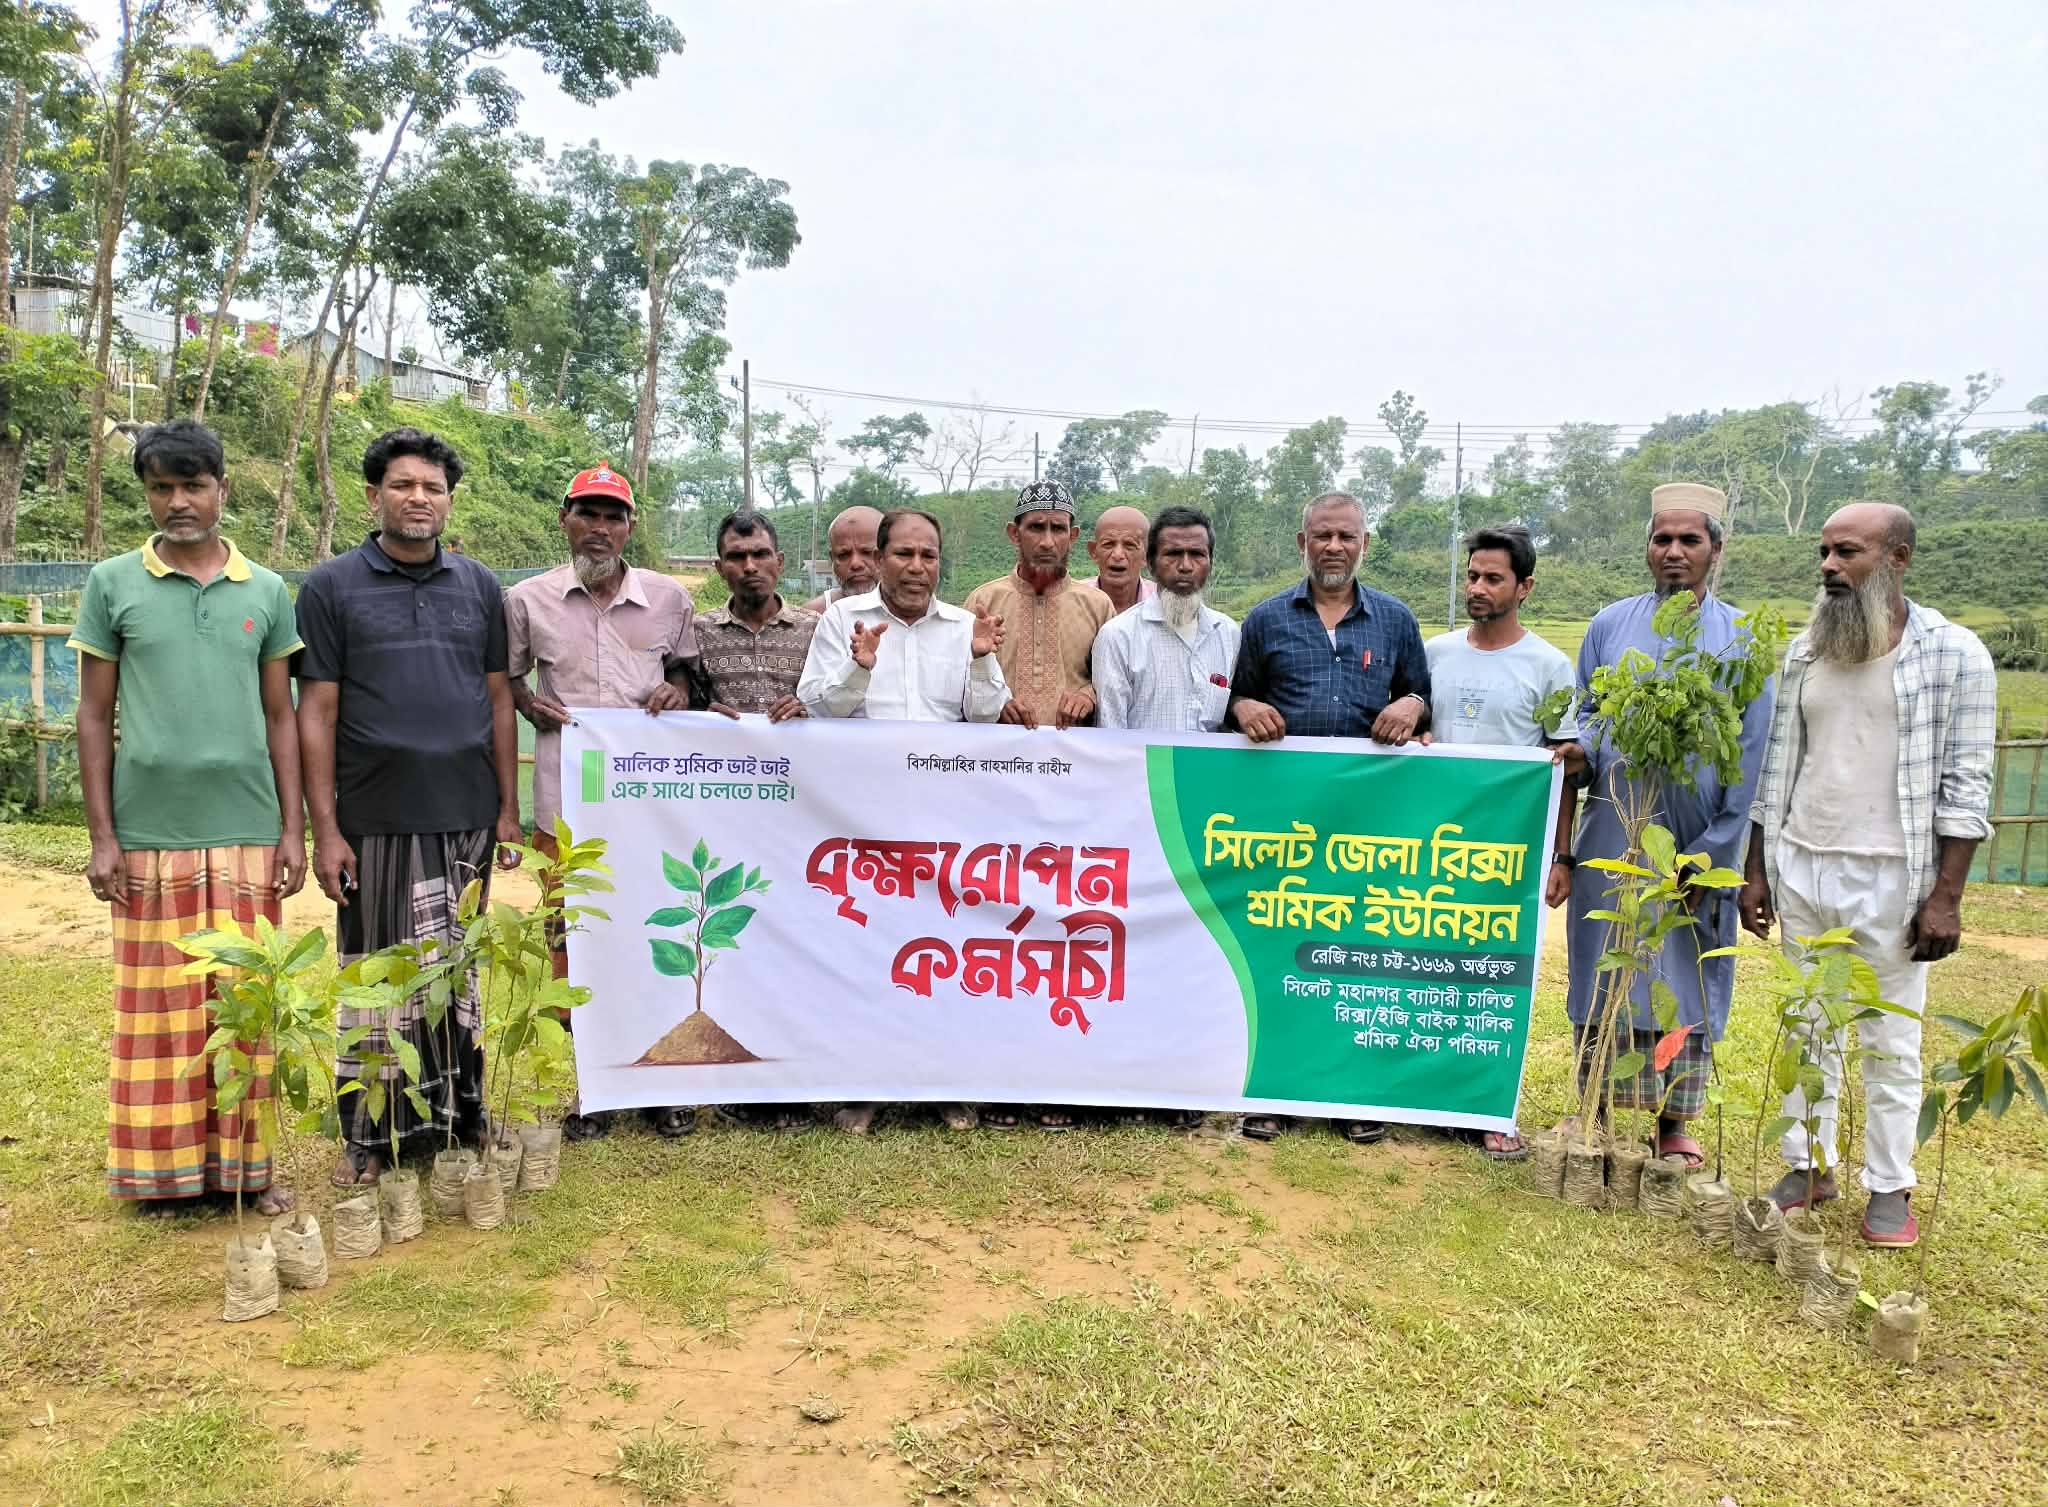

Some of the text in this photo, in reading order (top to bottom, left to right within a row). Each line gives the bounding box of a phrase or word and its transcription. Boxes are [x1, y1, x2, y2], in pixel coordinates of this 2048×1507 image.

[613, 752, 790, 777] মালিক শ্রমিক ভাই ভাই
[907, 753, 1072, 776] বিসমিল্লাহির রাহমানির রাহীম
[612, 781, 648, 799] এক
[652, 782, 694, 799] সাথে
[700, 783, 753, 800] চলতে
[1203, 812, 1528, 886] সিলেট জেলা রিক্সা
[805, 837, 1129, 926] বৃক্ষরোপন
[1246, 875, 1521, 946] শ্রমিক ইউনিয়ন
[890, 907, 1126, 1035] কর্মসূচী
[1311, 946, 1348, 967] রেজি
[1283, 975, 1515, 1010] সিলেট মহানগর ব্যাটারী চালিত
[1334, 1001, 1515, 1033] রিক্সা/ইজি বাইক মালিক
[1353, 1027, 1400, 1048] শ্রমিক
[1405, 1027, 1442, 1052] ঐক্য
[1448, 1033, 1501, 1056] পরিষদ
